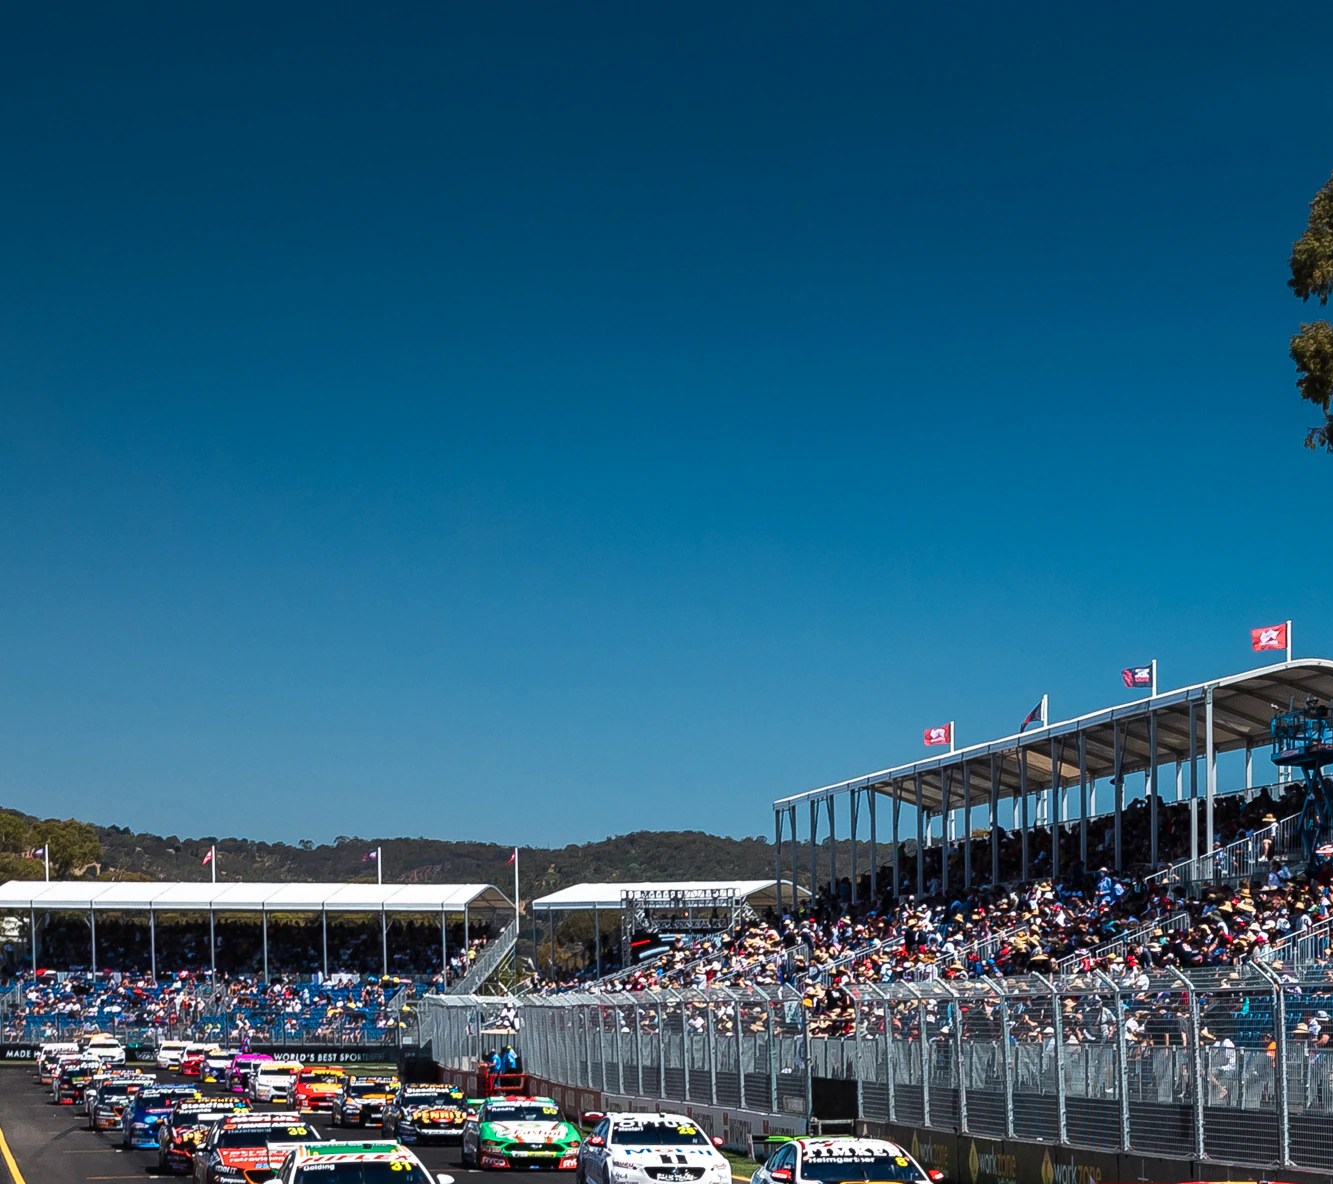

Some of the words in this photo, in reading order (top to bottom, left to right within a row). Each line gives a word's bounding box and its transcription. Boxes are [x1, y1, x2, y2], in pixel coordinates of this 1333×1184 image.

[6, 1050, 32, 1059] MADE
[273, 1052, 315, 1062] WORLD'S
[317, 1052, 338, 1062] BEST
[287, 1127, 308, 1136] 35
[803, 1147, 903, 1157] TIMKEN
[301, 1154, 411, 1164] HIFLEX
[896, 1156, 909, 1167] 8
[979, 1146, 1017, 1178] workzone
[303, 1163, 335, 1172] Golding
[390, 1161, 412, 1172] 31
